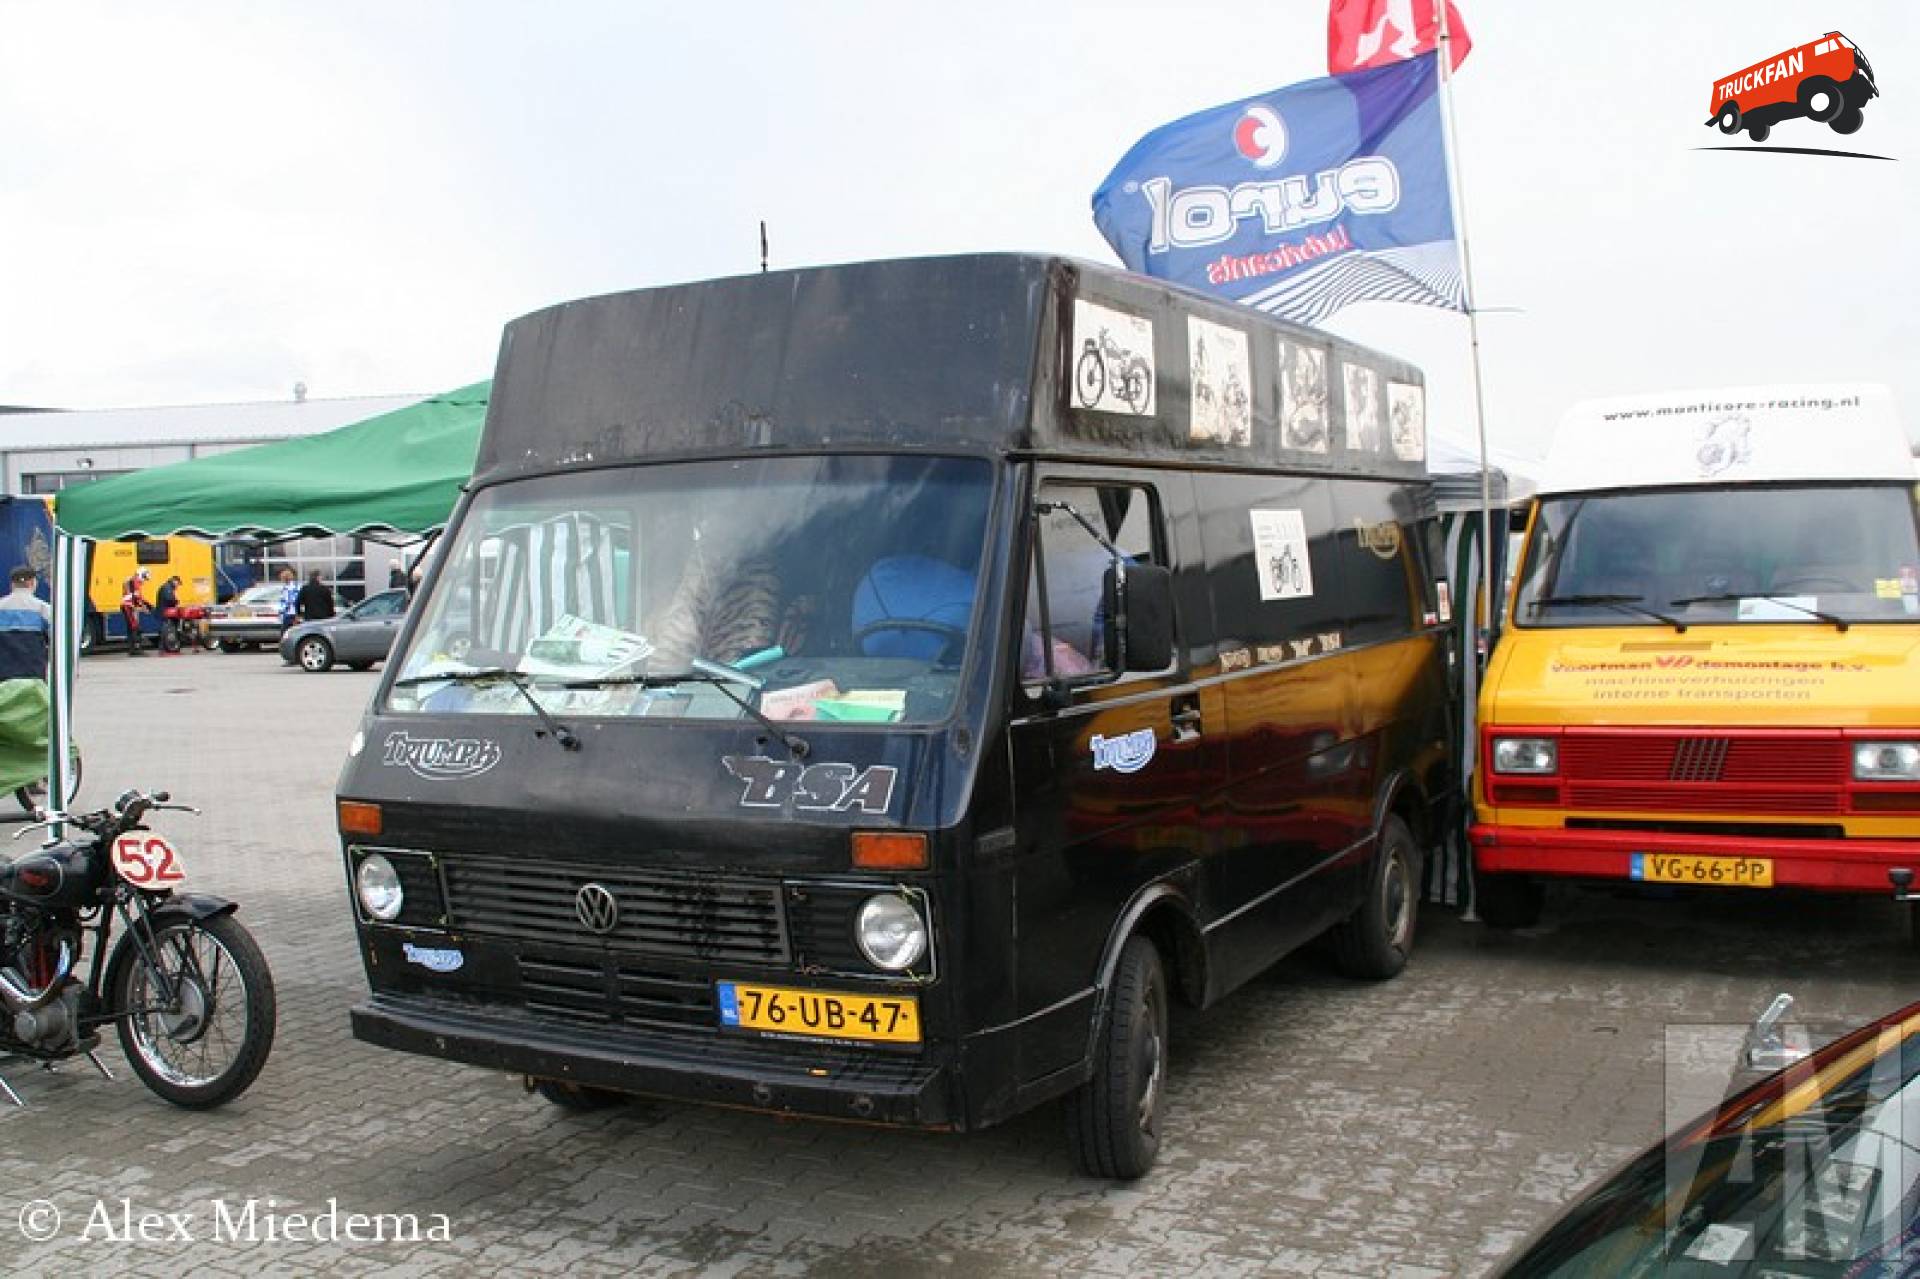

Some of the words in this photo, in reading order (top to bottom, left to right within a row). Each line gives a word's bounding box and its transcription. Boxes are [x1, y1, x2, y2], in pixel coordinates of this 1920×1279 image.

[722, 755, 899, 815] BSA
[118, 838, 186, 883] 52
[1651, 857, 1766, 882] VG-66-PP
[745, 990, 902, 1033] 76-UB-47
